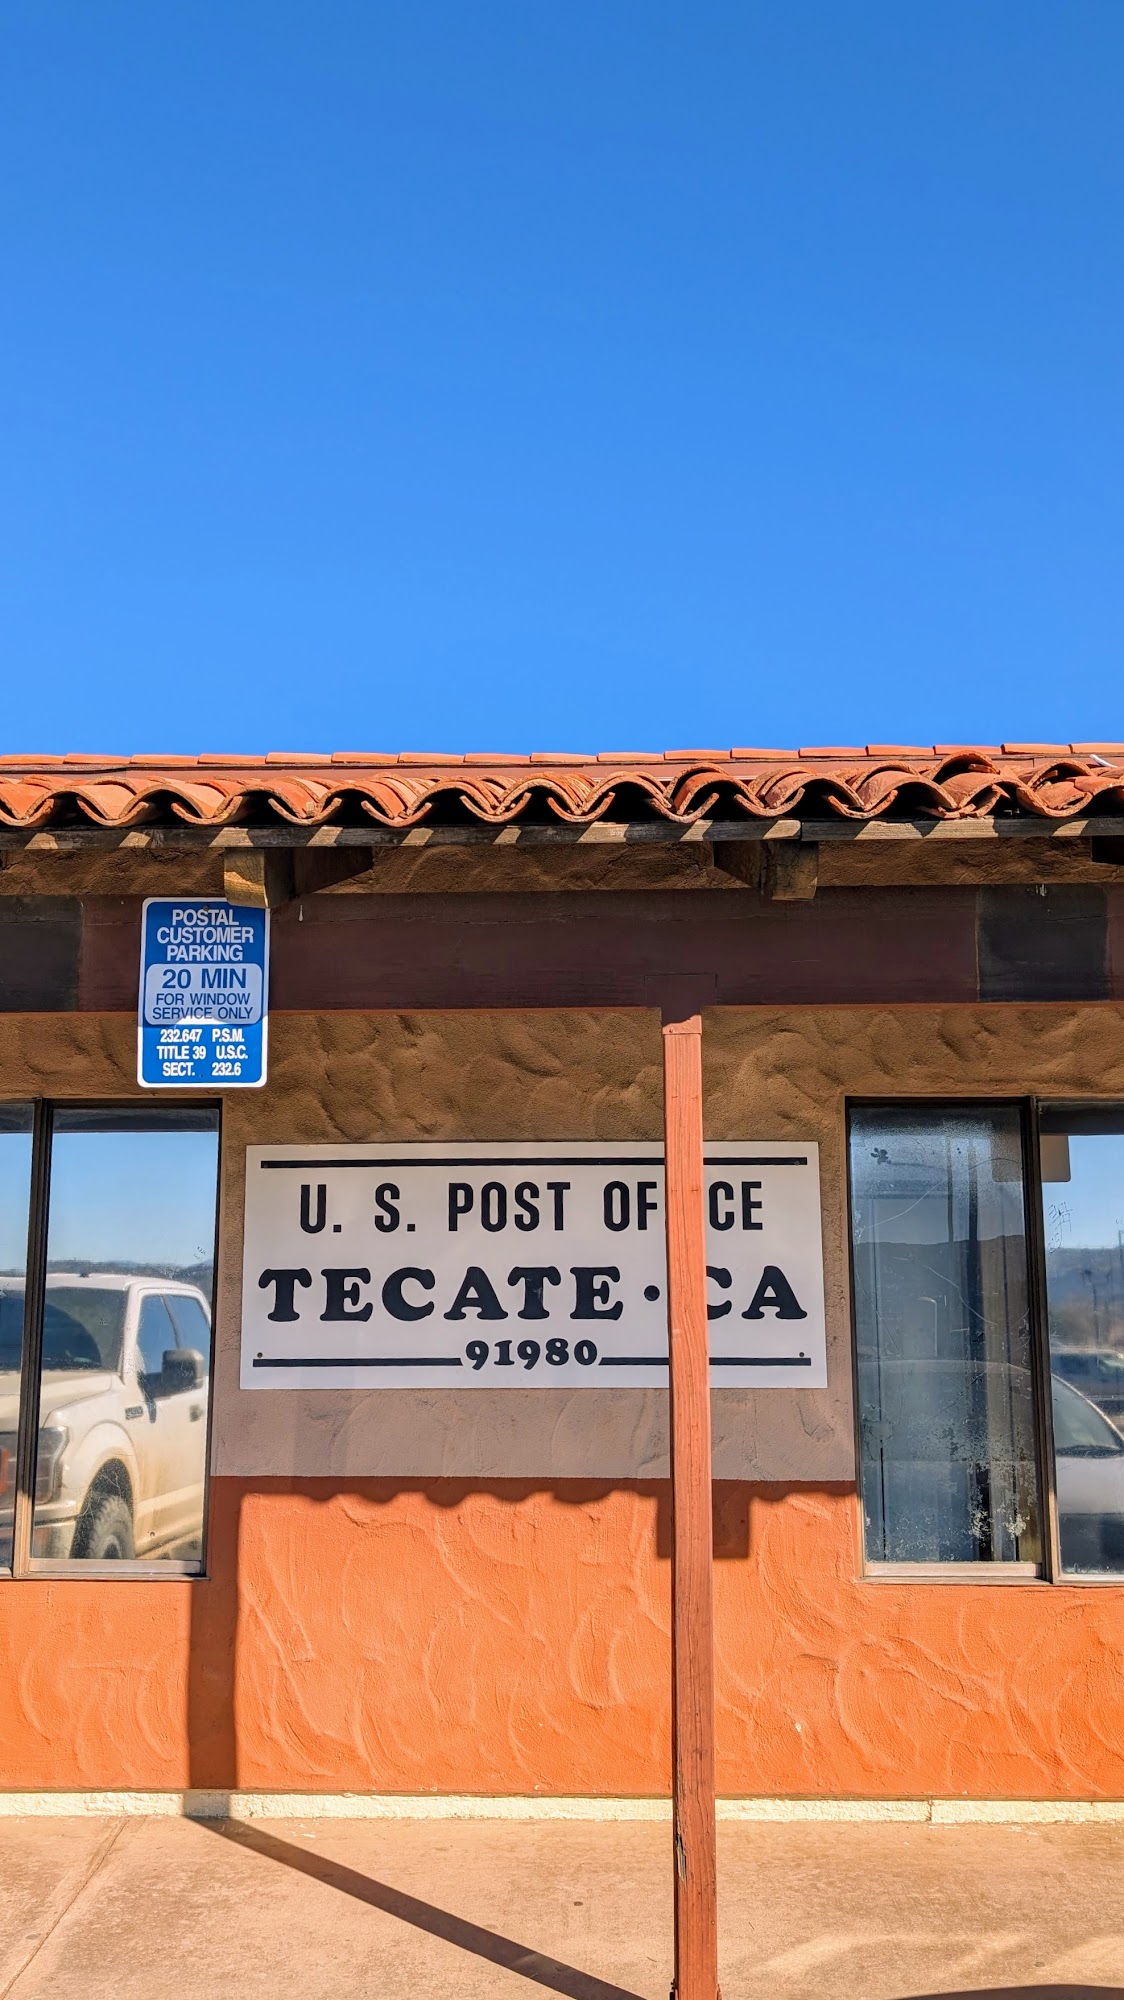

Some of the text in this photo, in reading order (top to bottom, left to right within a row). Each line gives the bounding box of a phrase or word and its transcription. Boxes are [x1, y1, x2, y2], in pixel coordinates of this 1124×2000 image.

[172, 909, 239, 926] POSTAL
[156, 927, 254, 944] CUSTOMER
[166, 945, 243, 962] PARKING
[162, 968, 247, 989] 20 MIN
[155, 993, 251, 1006] FOR WINDOW
[152, 1006, 254, 1020] SERVICE ONLY
[160, 1028, 245, 1043] 232.647 P.S.M.
[156, 1045, 249, 1060] TITLE 39 U.S.C.
[162, 1062, 242, 1077] SECT. 232.6
[299, 1180, 764, 1233] U. S. POST OFCE
[257, 1265, 624, 1323] TECATE
[465, 1337, 599, 1371] 91980
